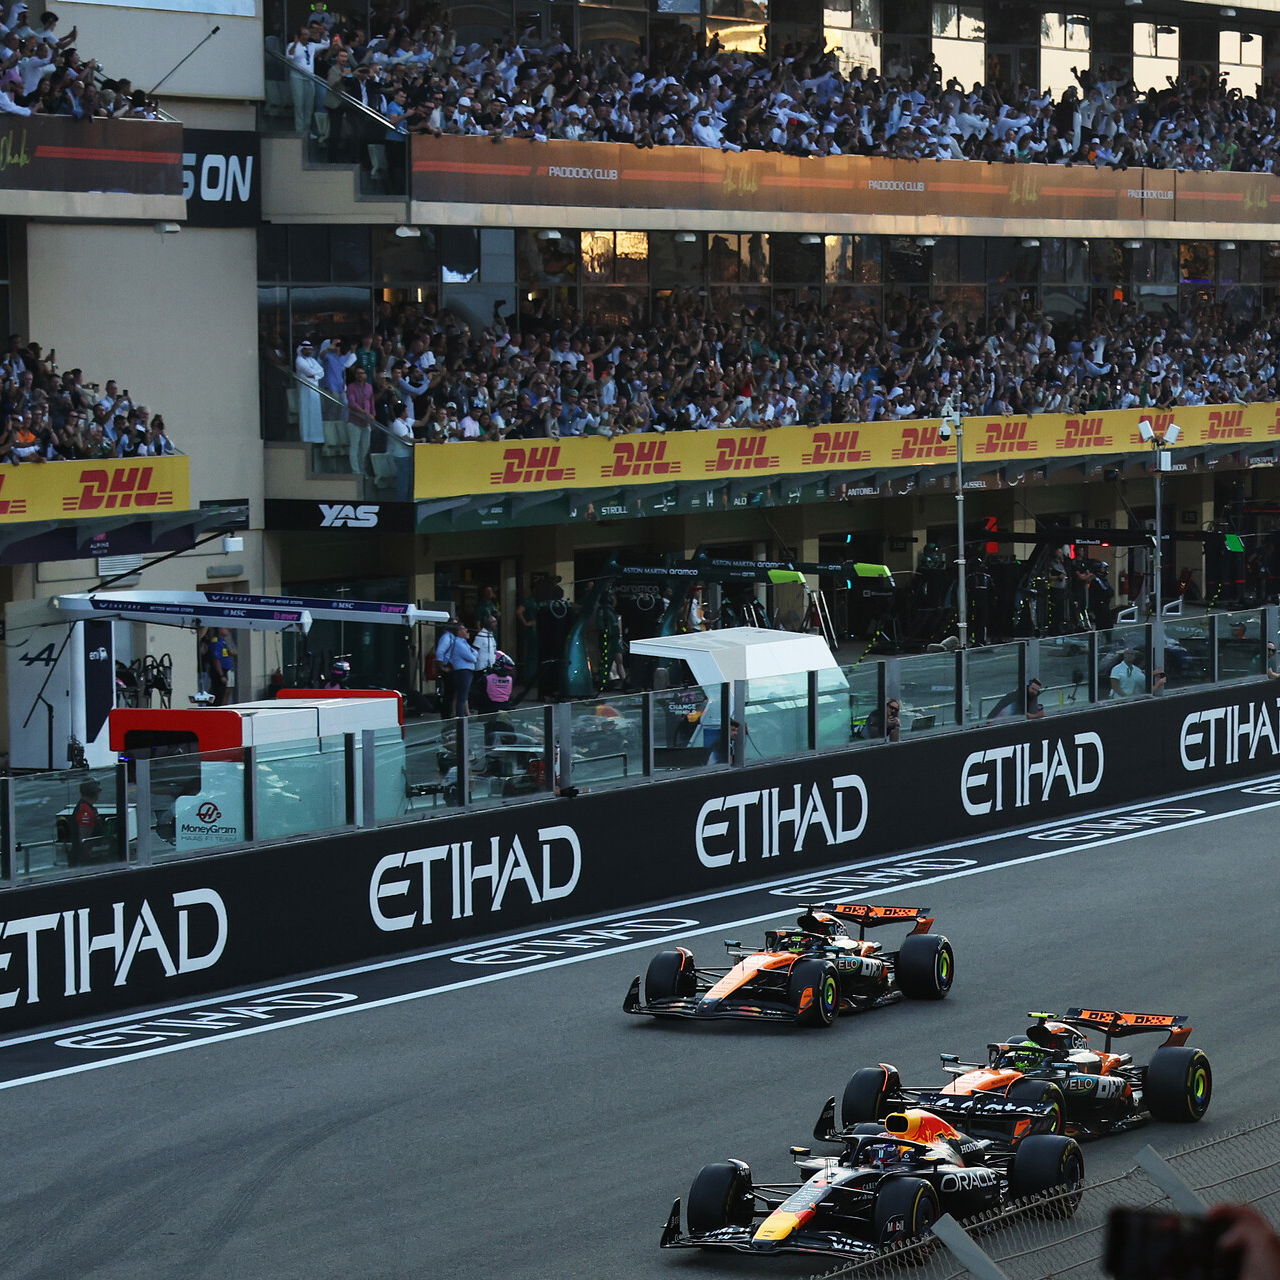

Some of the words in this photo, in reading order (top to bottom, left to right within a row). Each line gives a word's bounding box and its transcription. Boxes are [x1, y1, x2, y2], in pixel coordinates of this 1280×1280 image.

[548, 166, 593, 179] PADDOCK
[594, 169, 617, 181] CLUB
[868, 179, 904, 191] PADDOCK
[905, 181, 925, 192] CLUB
[985, 422, 1030, 453] DHL
[1064, 418, 1105, 448] DHL
[1207, 410, 1246, 439] DHL
[612, 441, 670, 476] DHL
[715, 436, 771, 471] DHL
[811, 431, 862, 464] DHL
[901, 427, 948, 459] DHL
[502, 446, 564, 484] DHL
[78, 467, 158, 510] DHL
[318, 504, 380, 528] YAS
[601, 506, 628, 515] STROLL
[961, 731, 1105, 816] ETIHAD
[181, 824, 237, 835] MoneyGram
[695, 774, 869, 869] ETIHAD
[1027, 808, 1207, 842] ETIHAD
[369, 825, 583, 932] ETIHAD
[769, 858, 979, 897] ETIHAD
[450, 917, 701, 965] ETIHAD
[54, 991, 359, 1050] ETIHAD
[1061, 1078, 1092, 1091] VELO
[941, 1170, 997, 1193] ORACLE
